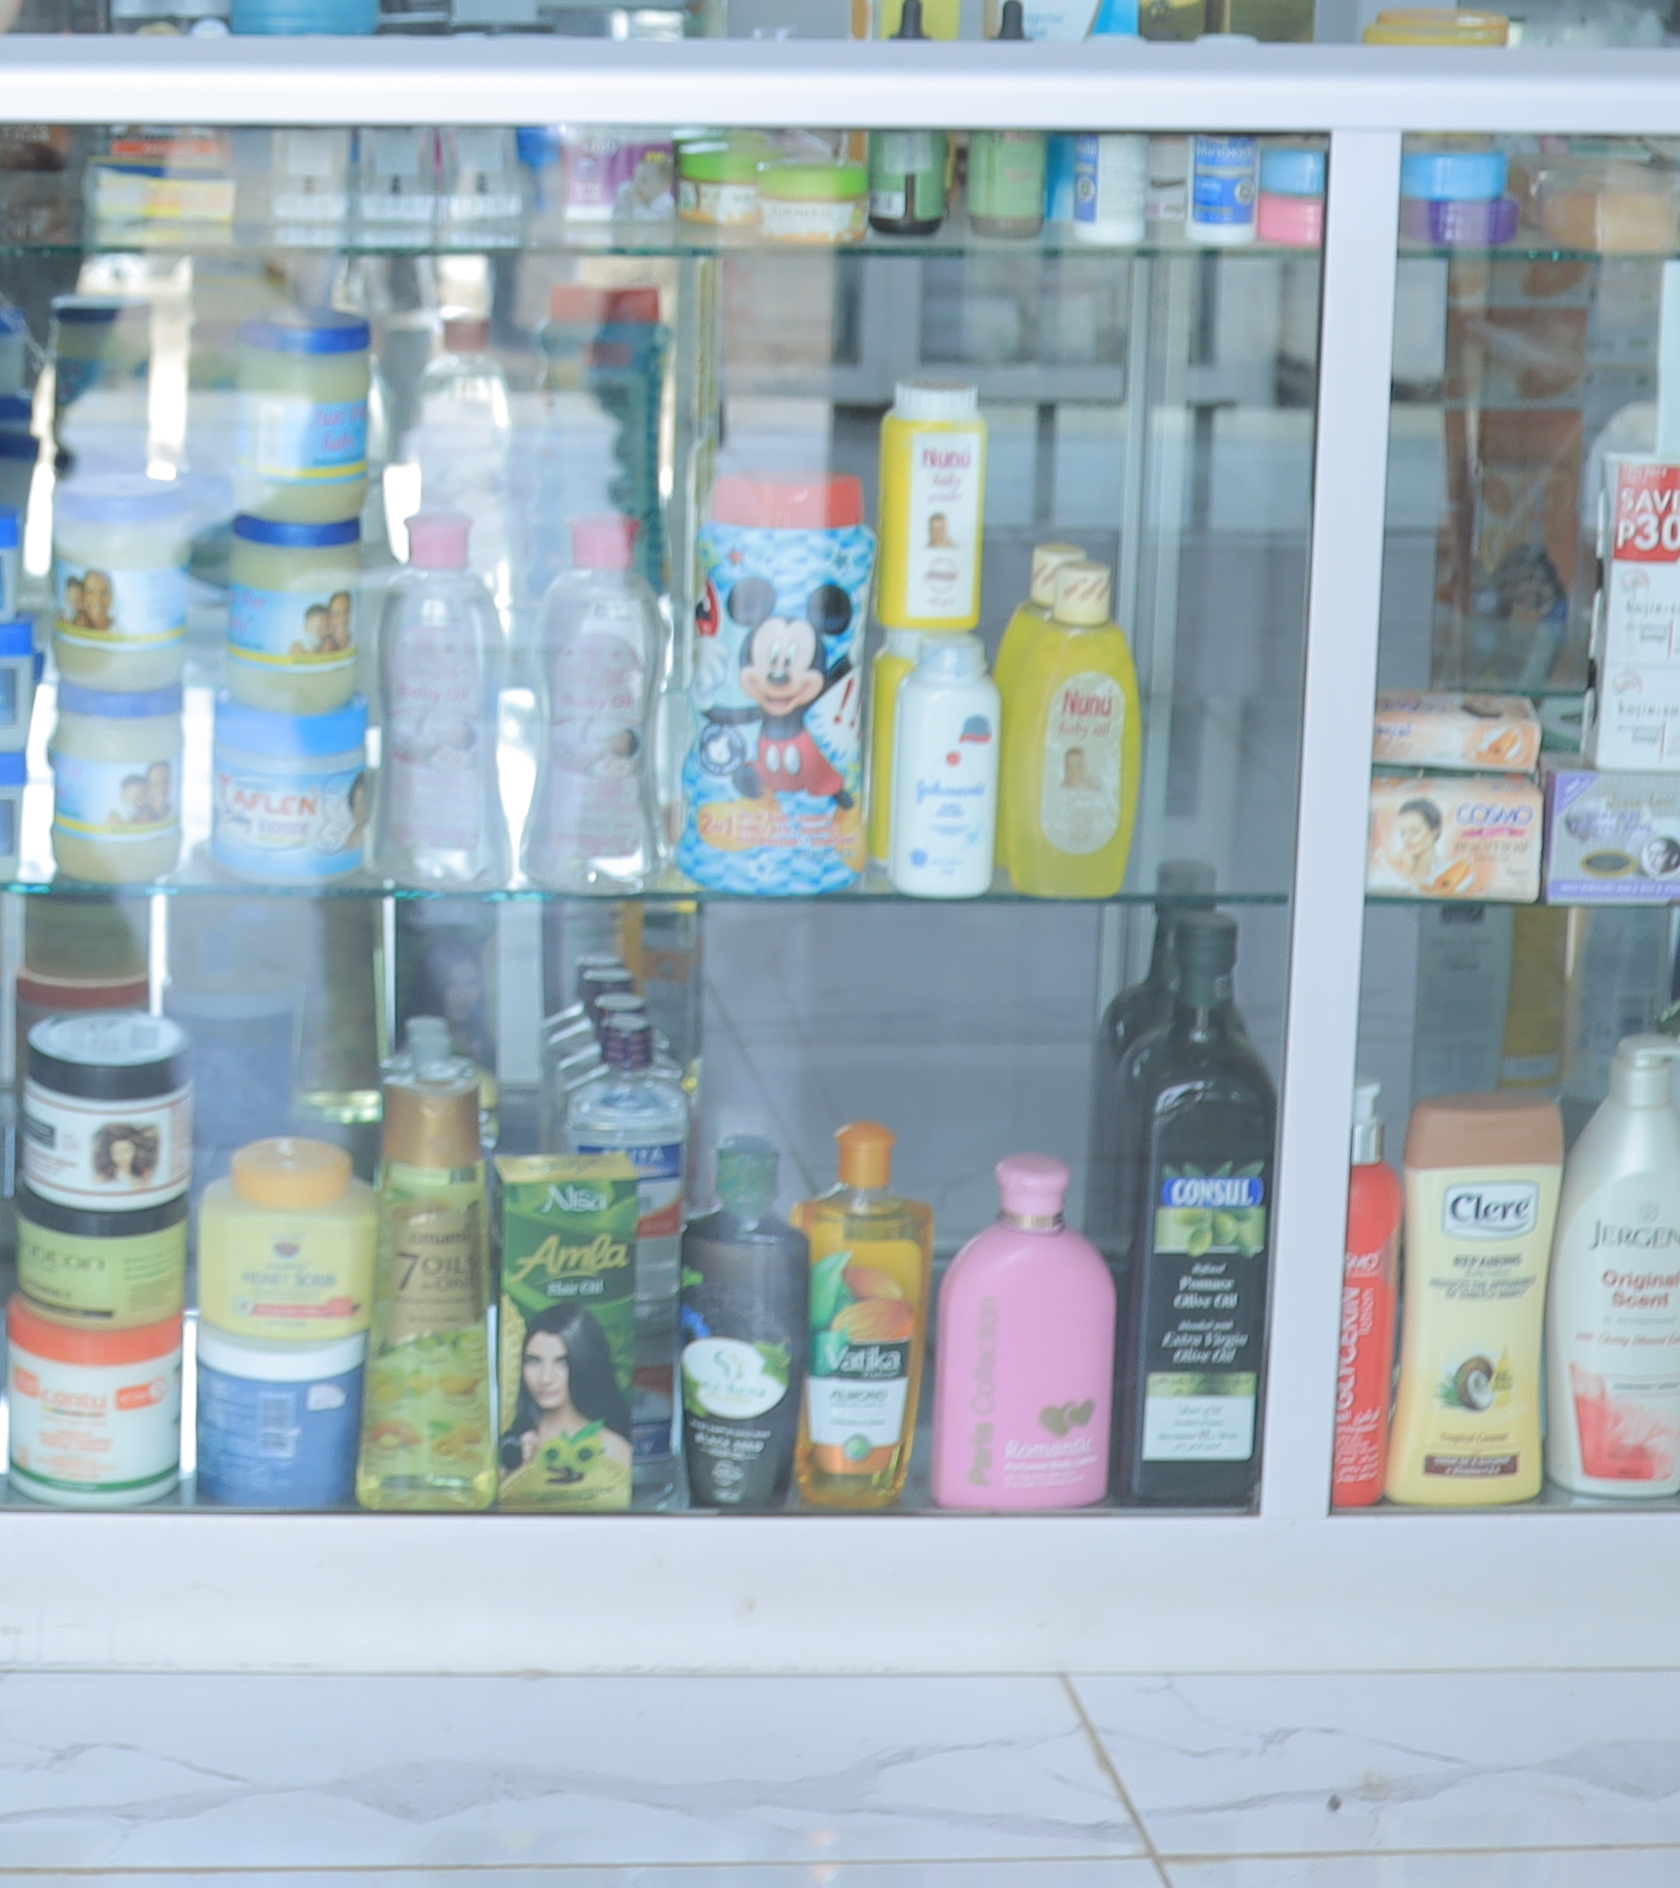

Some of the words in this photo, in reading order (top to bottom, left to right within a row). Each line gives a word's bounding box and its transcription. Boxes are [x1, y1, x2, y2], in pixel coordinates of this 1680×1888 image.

[1170, 1177, 1254, 1207] CONSUL
[509, 1232, 631, 1283] Amla
[1610, 1291, 1670, 1310] Scent
[822, 1344, 903, 1374] Vatika
